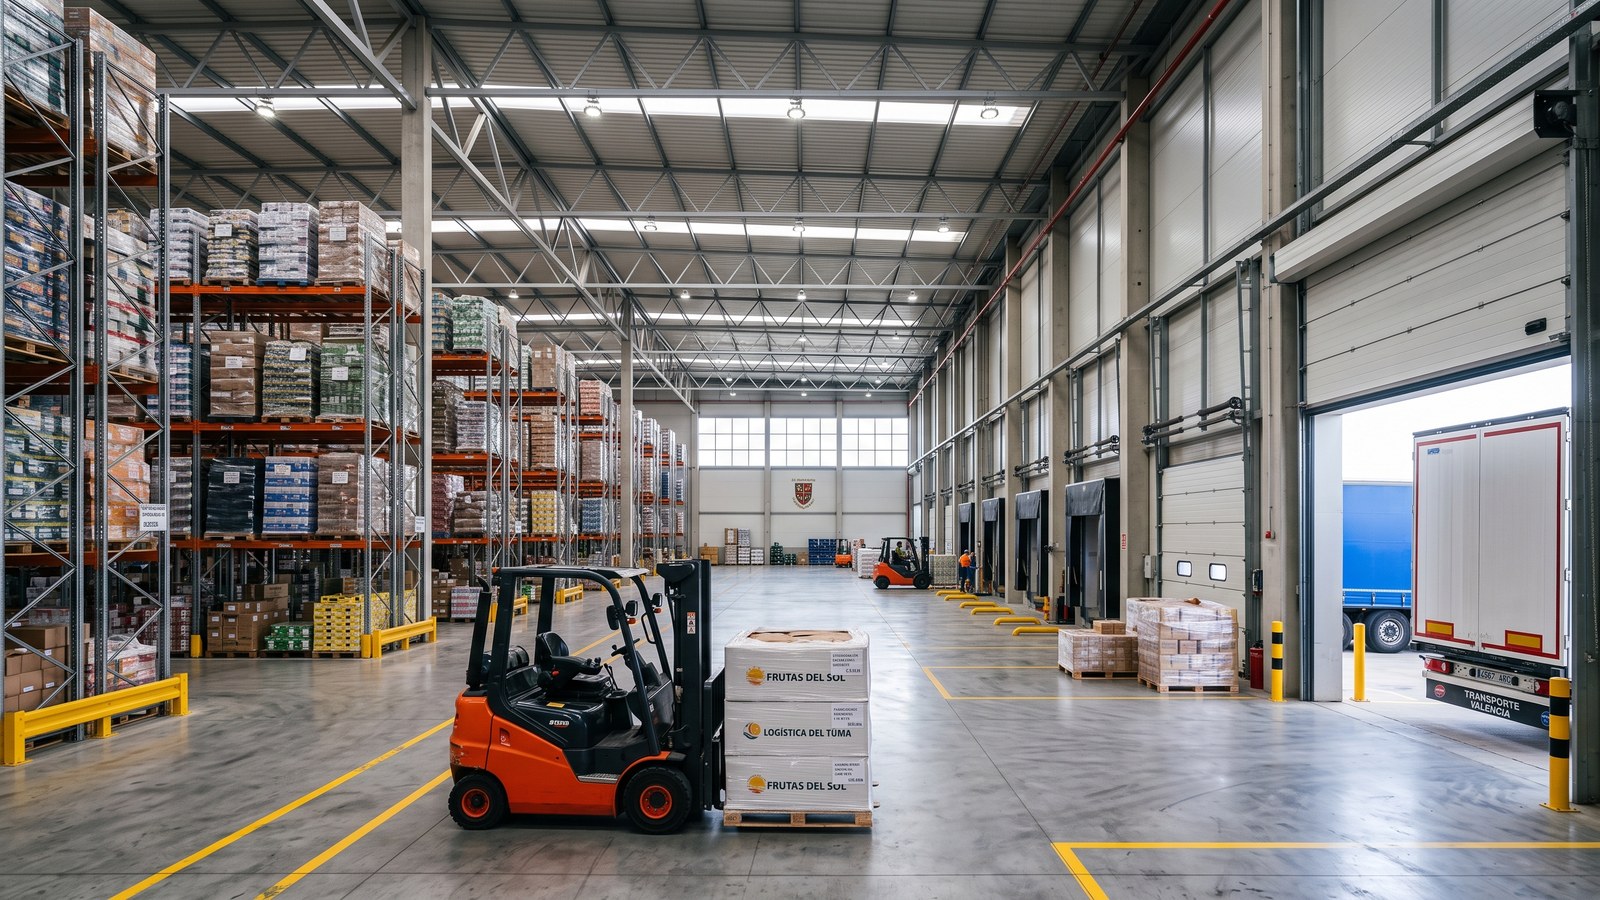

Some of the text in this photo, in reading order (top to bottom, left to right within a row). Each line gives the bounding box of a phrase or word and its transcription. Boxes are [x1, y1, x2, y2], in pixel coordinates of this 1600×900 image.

[766, 673, 846, 682] FRUTAS DEL SOL
[1464, 689, 1520, 711] TRANSPORTE
[1470, 700, 1511, 718] VALENCIA
[763, 727, 807, 737] LOGÍSTICA
[808, 729, 825, 737] DEL
[767, 781, 847, 791] FRUTAS DEL SOL
